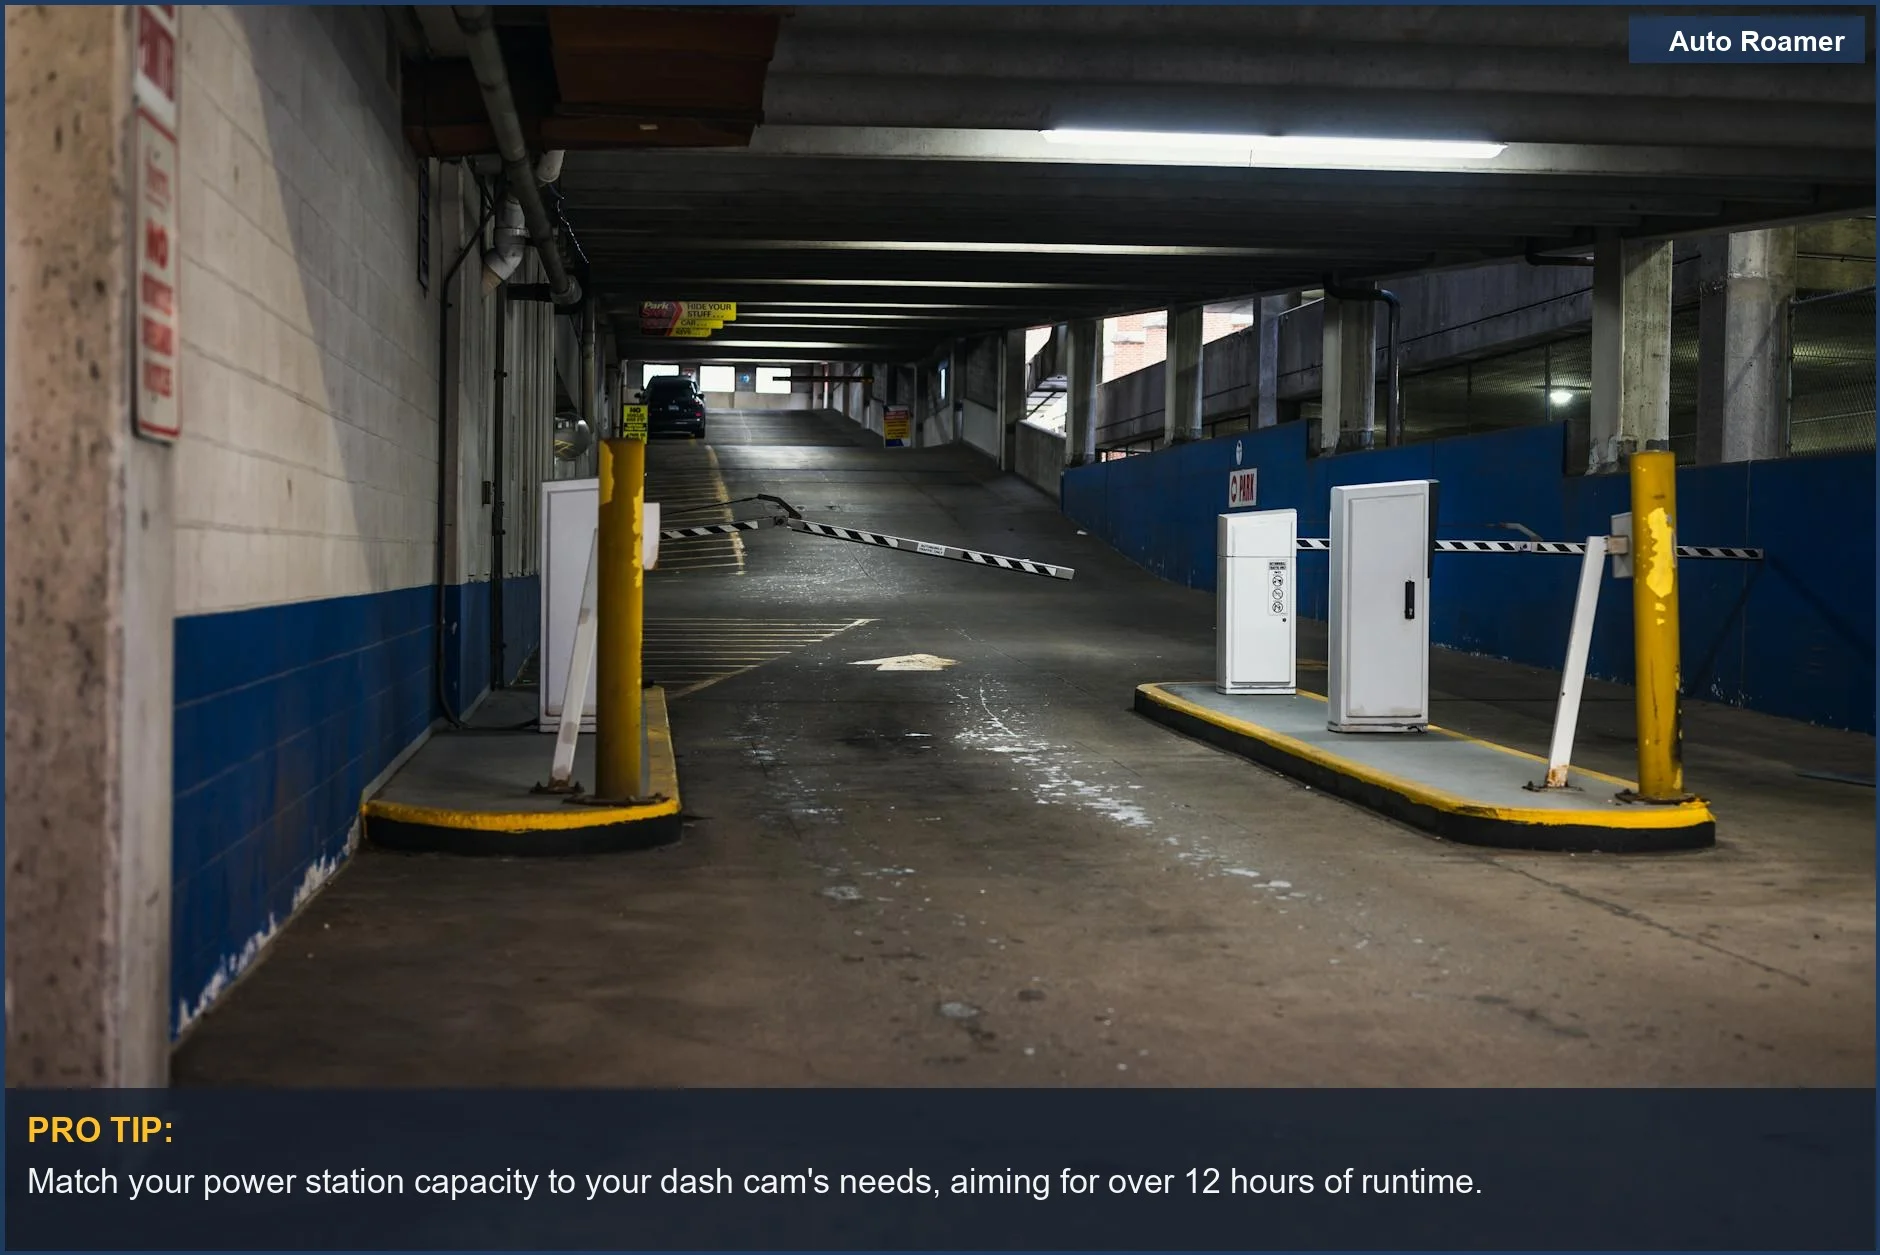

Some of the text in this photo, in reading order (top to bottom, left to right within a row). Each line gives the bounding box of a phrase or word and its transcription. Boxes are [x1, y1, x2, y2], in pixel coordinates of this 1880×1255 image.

[643, 302, 669, 310] Park
[687, 303, 732, 311] HIDE YOUR
[1239, 473, 1255, 502] PARK
